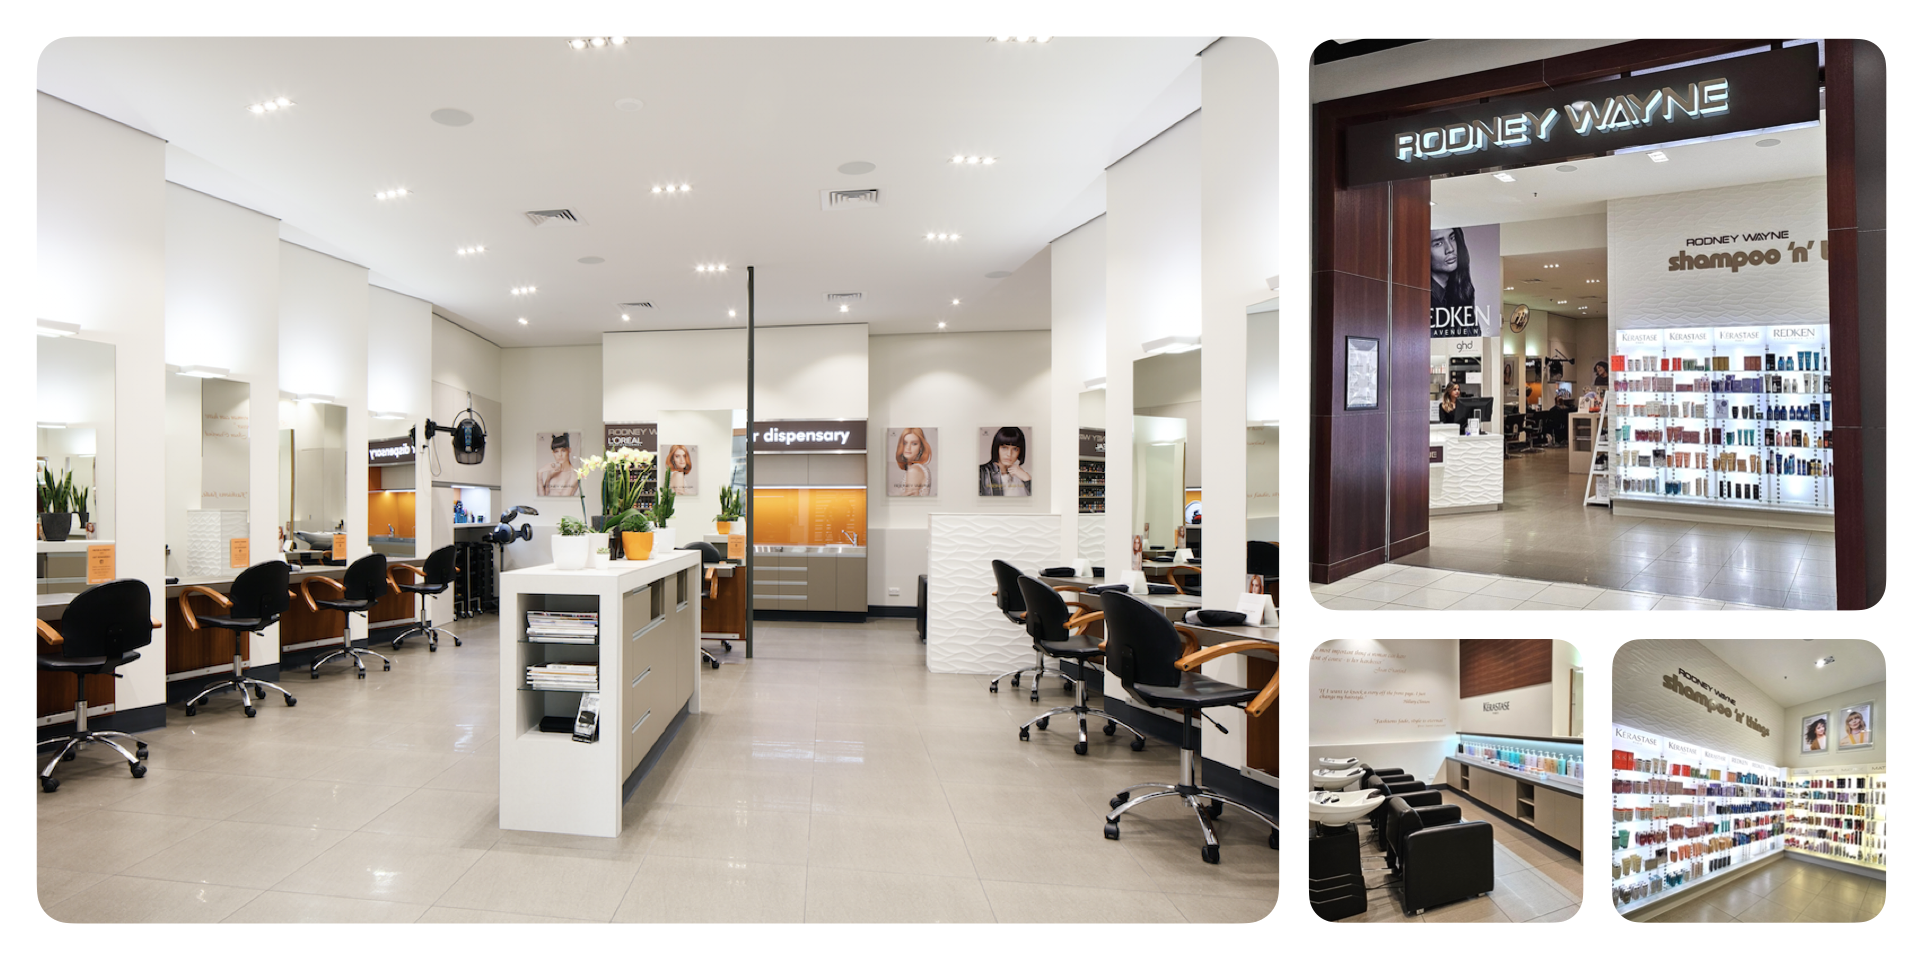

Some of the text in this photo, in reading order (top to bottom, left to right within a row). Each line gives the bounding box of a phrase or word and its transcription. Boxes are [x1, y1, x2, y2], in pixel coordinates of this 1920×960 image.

[1394, 77, 1730, 162] RODNEY WAYNE
[1686, 230, 1790, 247] RODNEY WAYNE
[1668, 248, 1781, 273] shampoo
[1773, 328, 1815, 337] REDKEN
[1456, 340, 1473, 353] ghd
[763, 428, 850, 445] dispensary
[1678, 668, 1714, 692] RODNEY
[1663, 674, 1732, 718] shampoo
[1746, 715, 1770, 738] things
